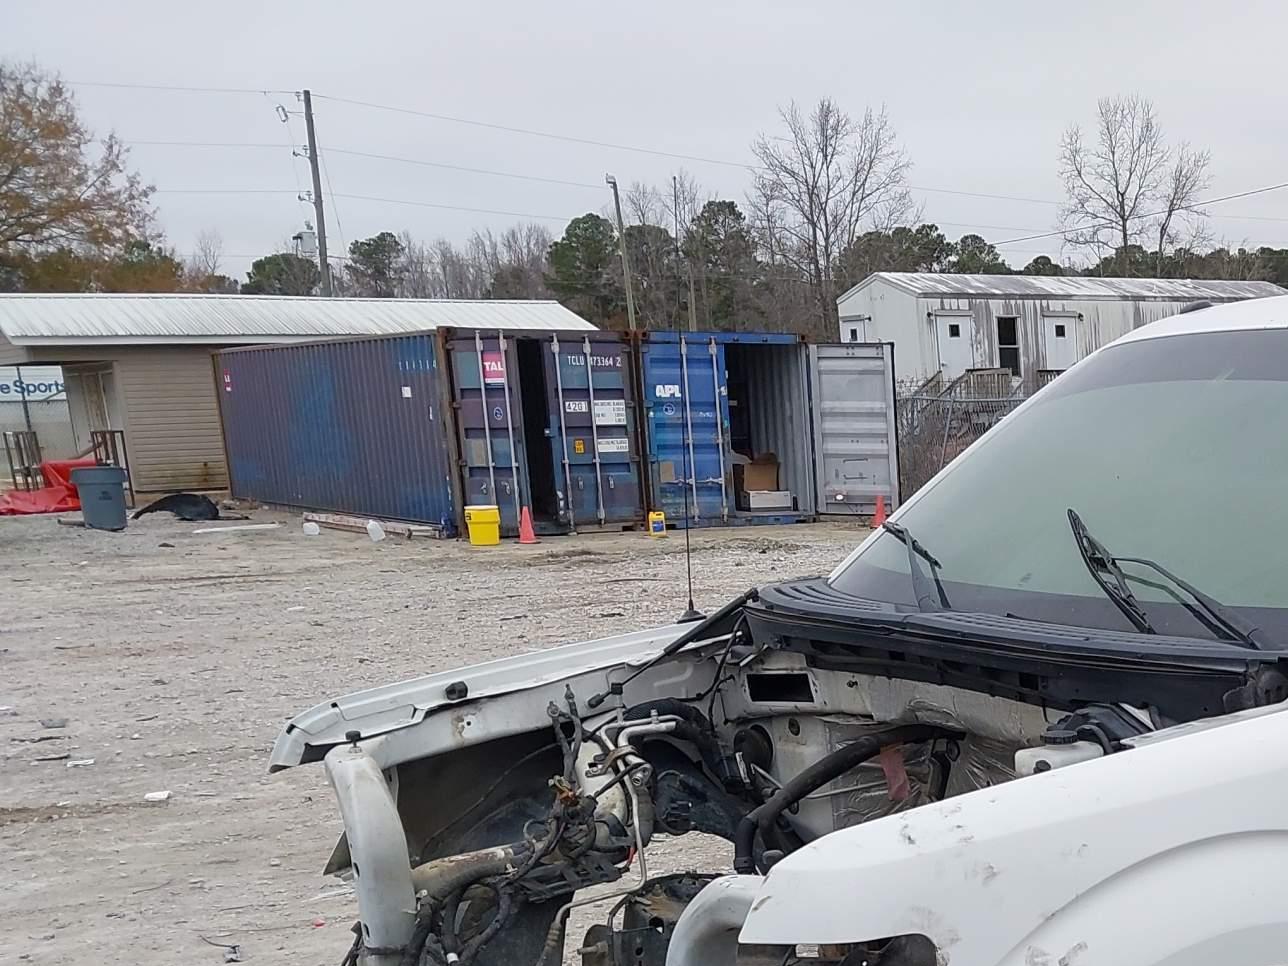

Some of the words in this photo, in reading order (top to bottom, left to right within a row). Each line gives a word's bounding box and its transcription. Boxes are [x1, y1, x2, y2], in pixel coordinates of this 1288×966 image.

[483, 361, 504, 371] TAL
[567, 355, 585, 366] TCLU
[656, 384, 682, 398] APL
